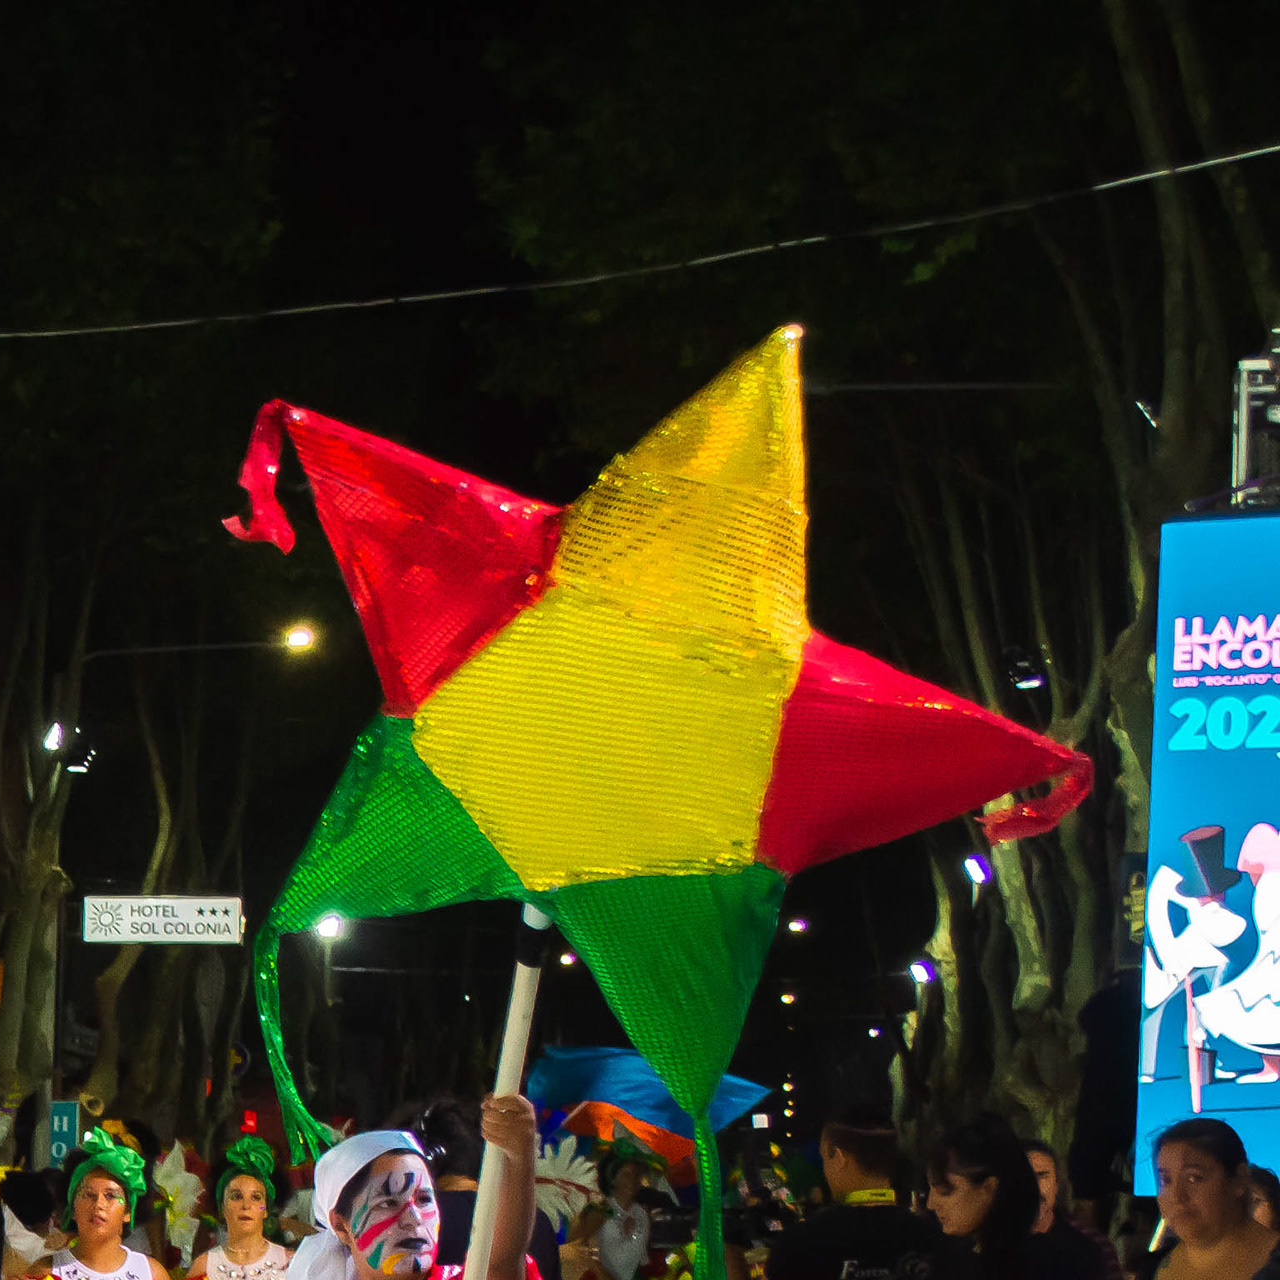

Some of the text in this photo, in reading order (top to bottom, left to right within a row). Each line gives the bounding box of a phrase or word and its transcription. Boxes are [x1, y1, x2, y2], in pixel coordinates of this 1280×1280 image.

[1172, 676, 1199, 688] LUIS
[130, 904, 179, 918] HOTEL
[130, 922, 232, 935] SOL COLONIA
